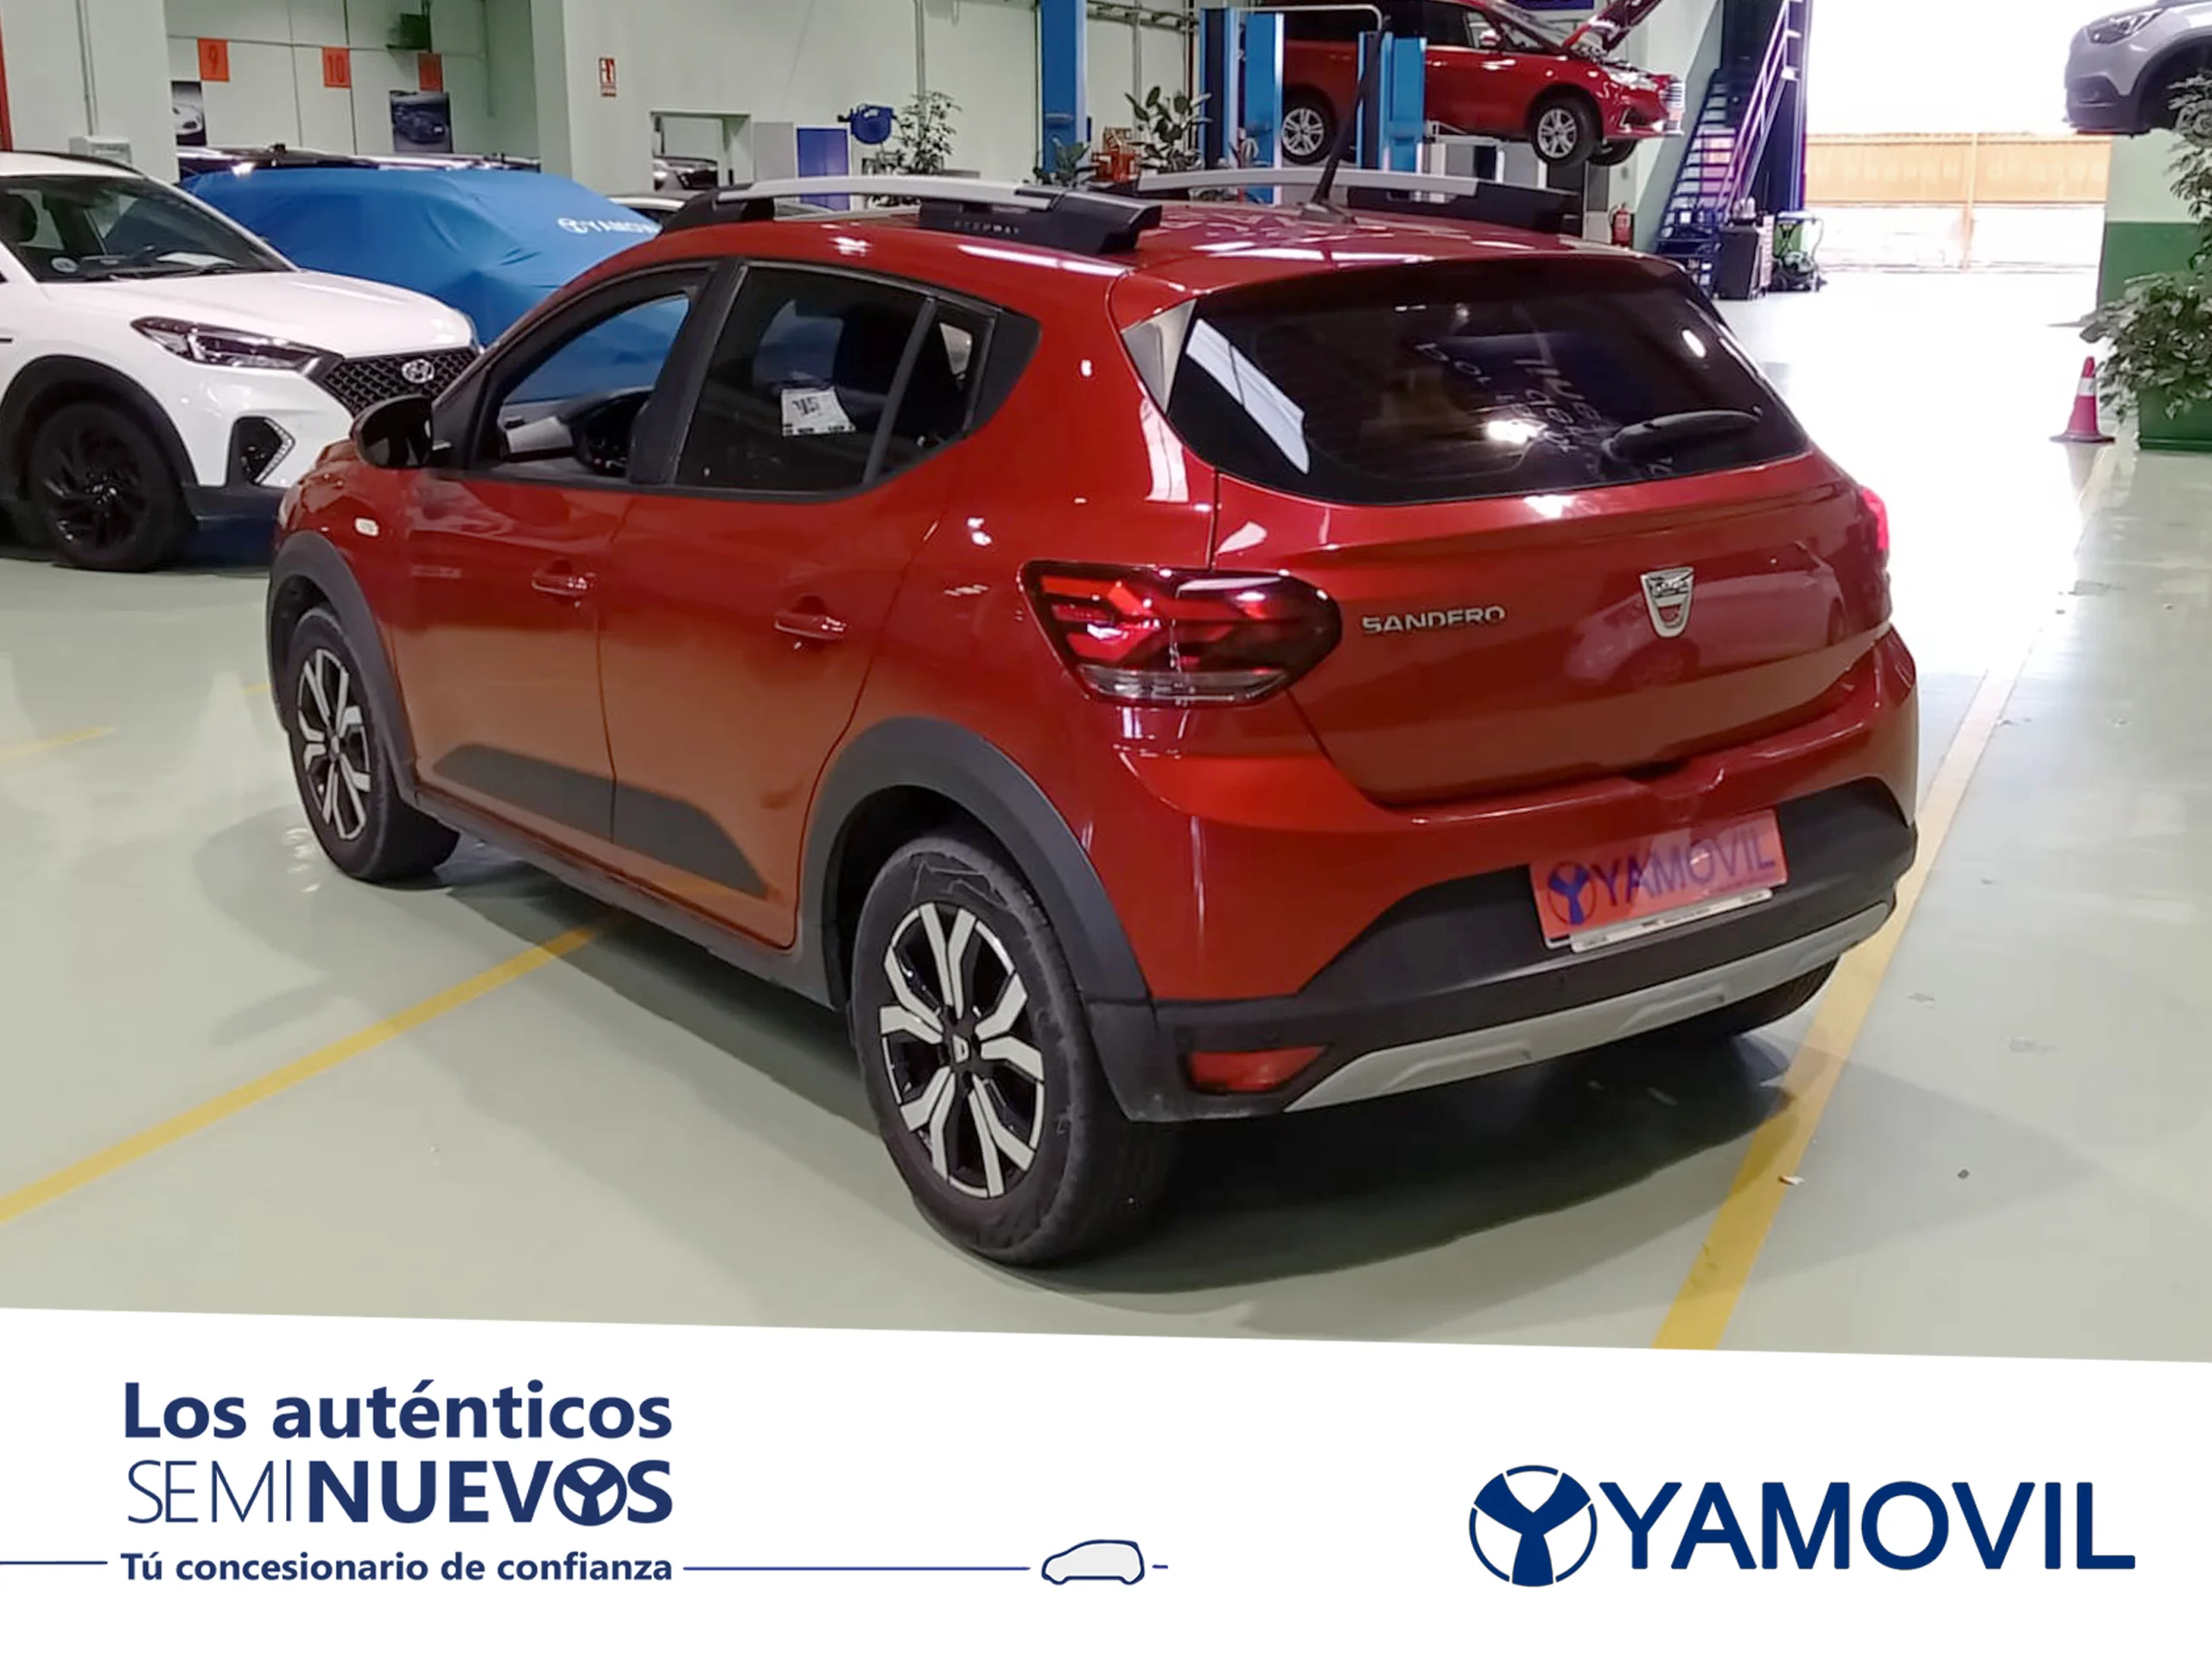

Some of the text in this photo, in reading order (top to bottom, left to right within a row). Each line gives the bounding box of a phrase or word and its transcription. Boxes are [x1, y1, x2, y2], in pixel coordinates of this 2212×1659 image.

[327, 54, 346, 83] 10
[1362, 605, 1506, 633] SANDERO
[1590, 826, 1776, 907] YAMOVIL
